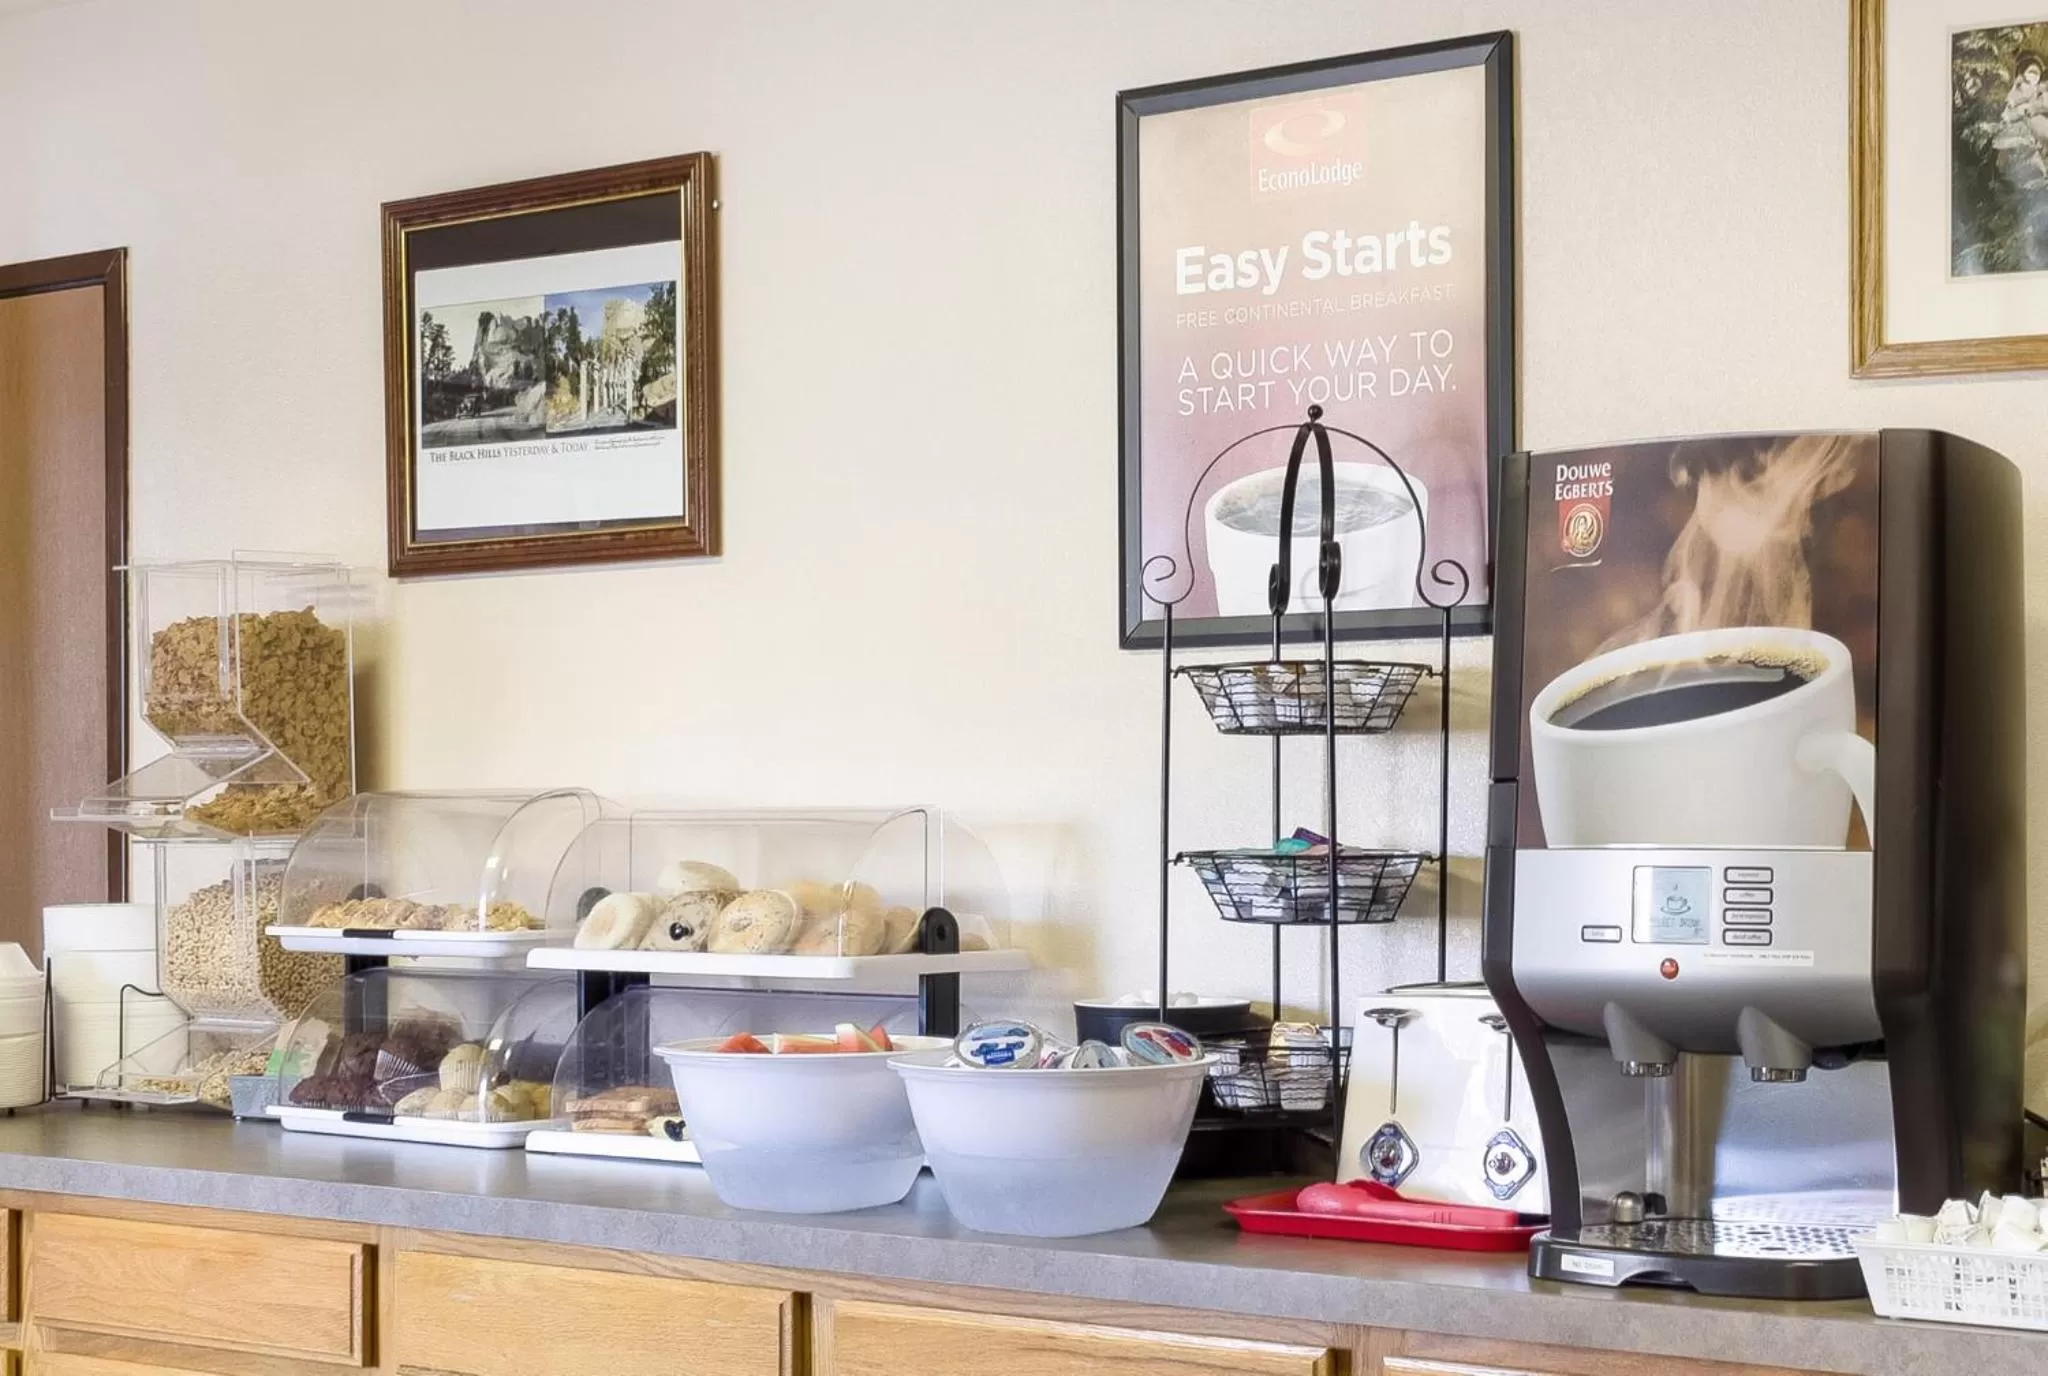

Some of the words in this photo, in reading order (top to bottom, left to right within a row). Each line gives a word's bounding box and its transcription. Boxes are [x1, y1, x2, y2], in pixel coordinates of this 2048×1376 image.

[1175, 243, 1290, 296] Easy
[1301, 220, 1453, 281] Starts
[1176, 311, 1218, 329] FREE
[1224, 298, 1345, 325] CONTINENTAL
[1350, 283, 1457, 310] BREAKFAST.
[1177, 355, 1200, 384] A
[1210, 343, 1313, 381] QUICK
[1324, 334, 1399, 369] WAY
[1409, 328, 1455, 361] TO
[1177, 380, 1277, 416] START
[1287, 371, 1378, 406] YOUR
[1389, 363, 1457, 398] DAY.
[429, 451, 447, 464] THE
[449, 449, 477, 462] BLACK
[477, 446, 502, 461] HILLS
[503, 444, 550, 459] YESTERDAY
[560, 441, 589, 455] TODAY
[1554, 480, 1614, 501] EGBERTS
